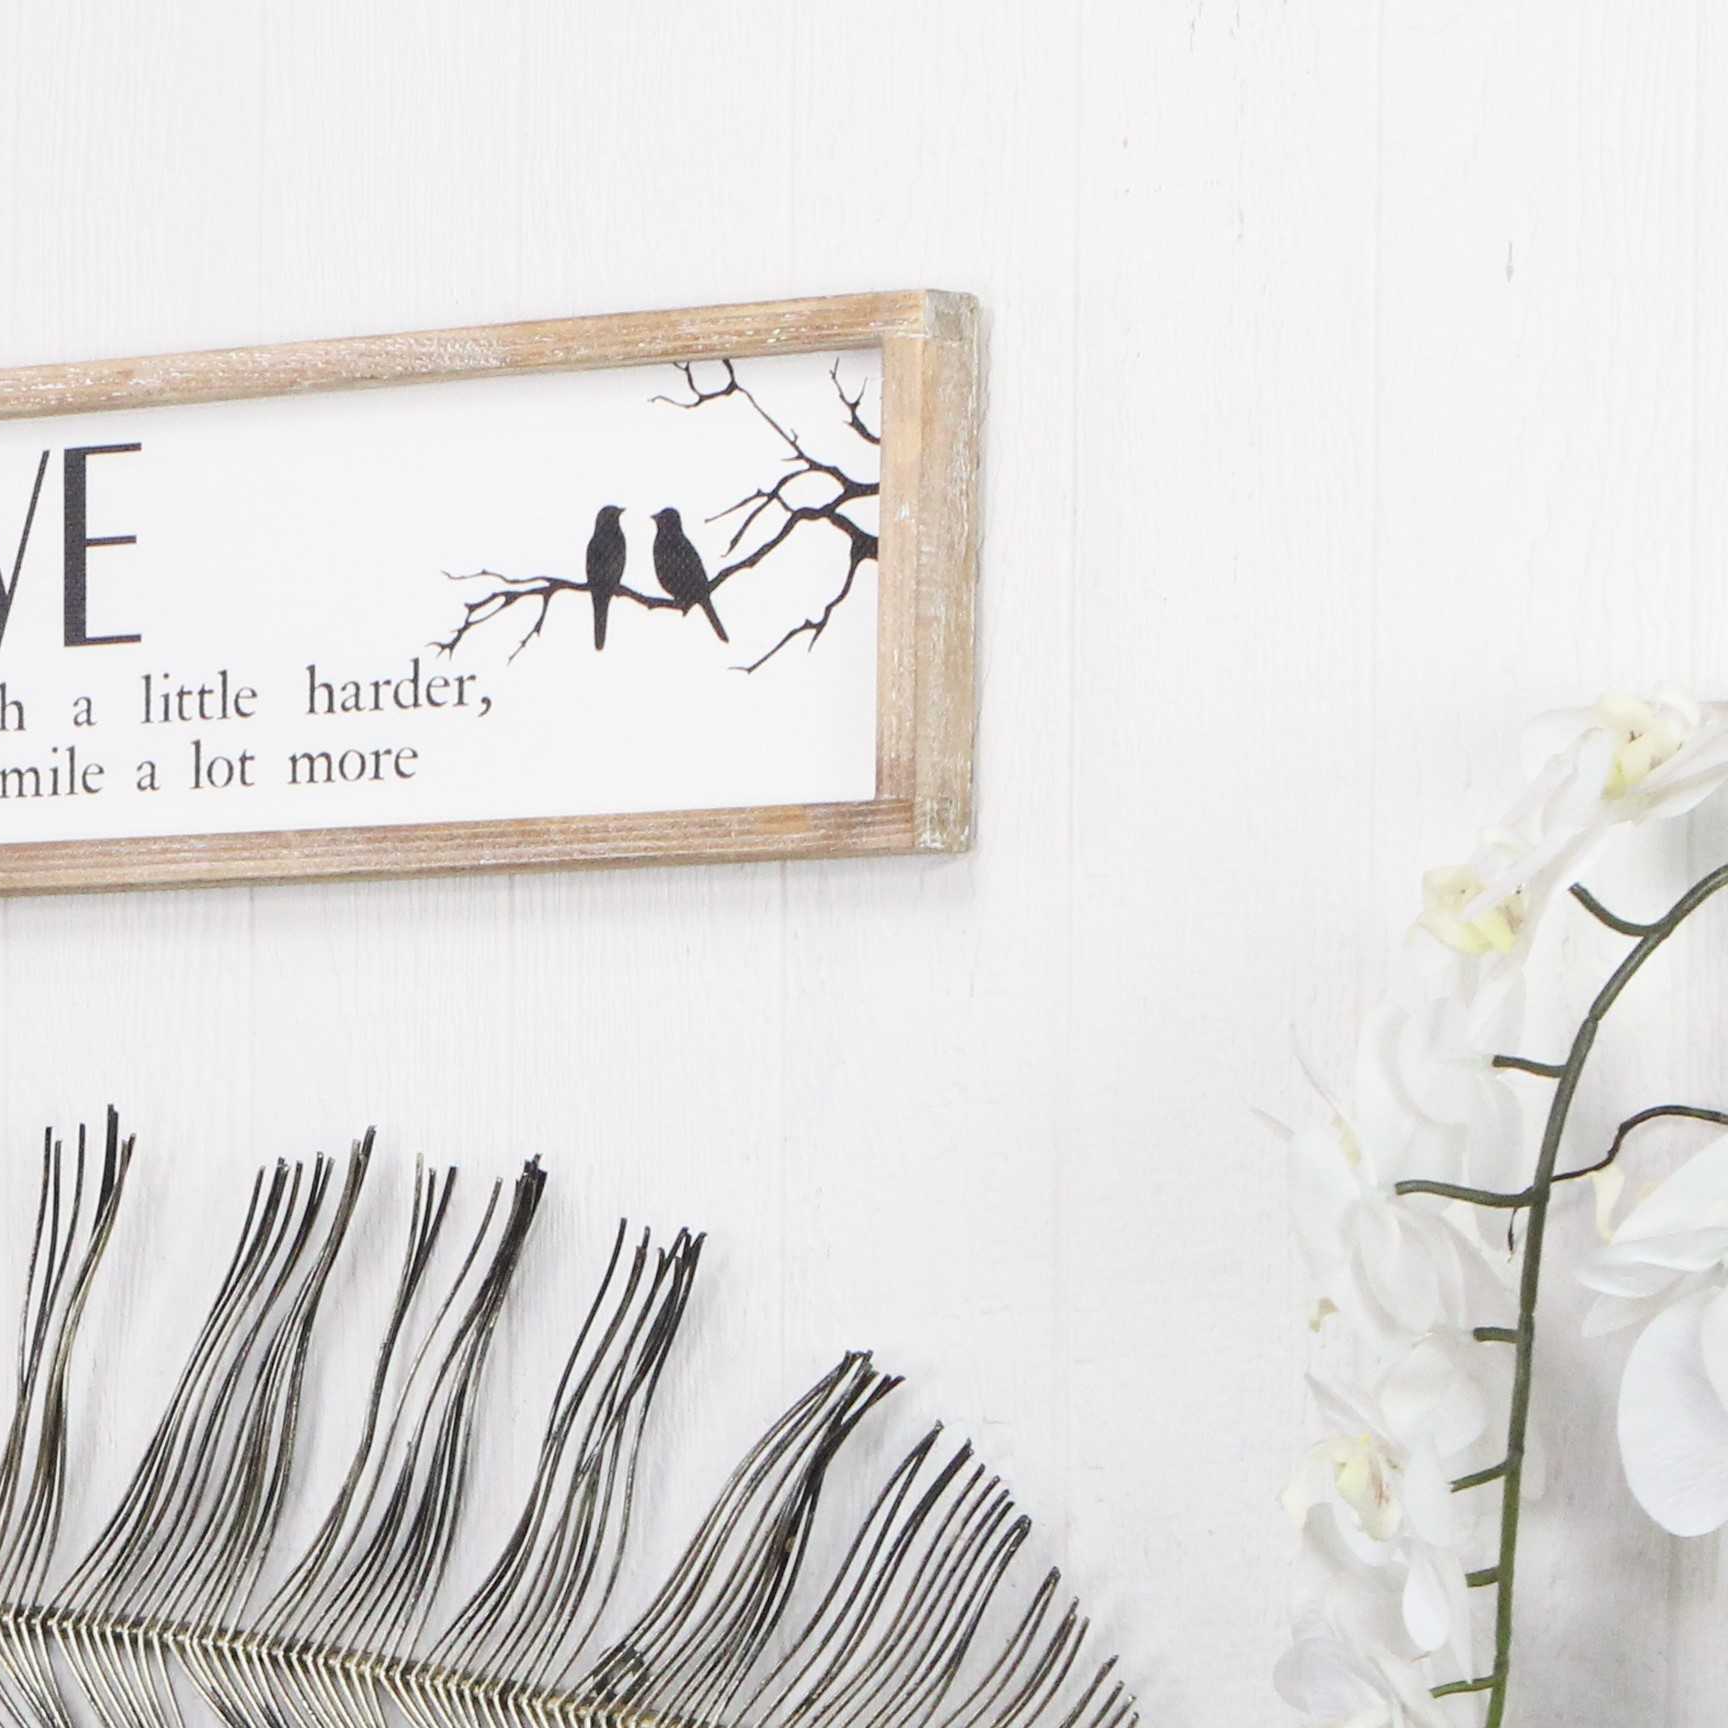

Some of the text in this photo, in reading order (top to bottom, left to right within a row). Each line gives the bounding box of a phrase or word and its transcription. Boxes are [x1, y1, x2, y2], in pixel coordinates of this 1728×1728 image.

[72, 696, 97, 727] a
[140, 669, 258, 724] little
[305, 657, 494, 717] harder,
[136, 759, 161, 791] a
[190, 739, 256, 790] lot
[287, 746, 420, 785] more
